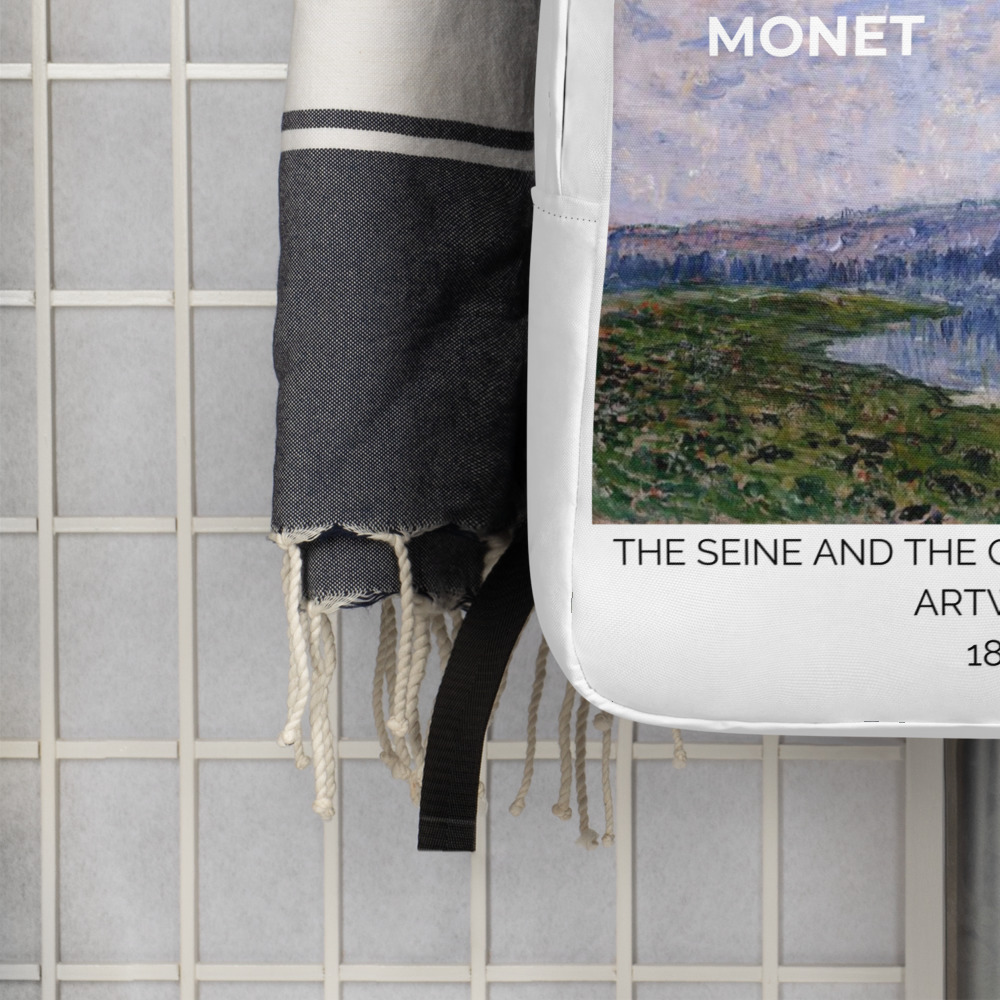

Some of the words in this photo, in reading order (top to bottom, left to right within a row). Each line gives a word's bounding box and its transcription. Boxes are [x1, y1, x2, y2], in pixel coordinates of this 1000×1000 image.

[707, 15, 926, 58] MONET
[612, 538, 686, 566] THE
[696, 538, 803, 567] SEINE
[811, 538, 894, 566] AND
[903, 538, 977, 566] THE
